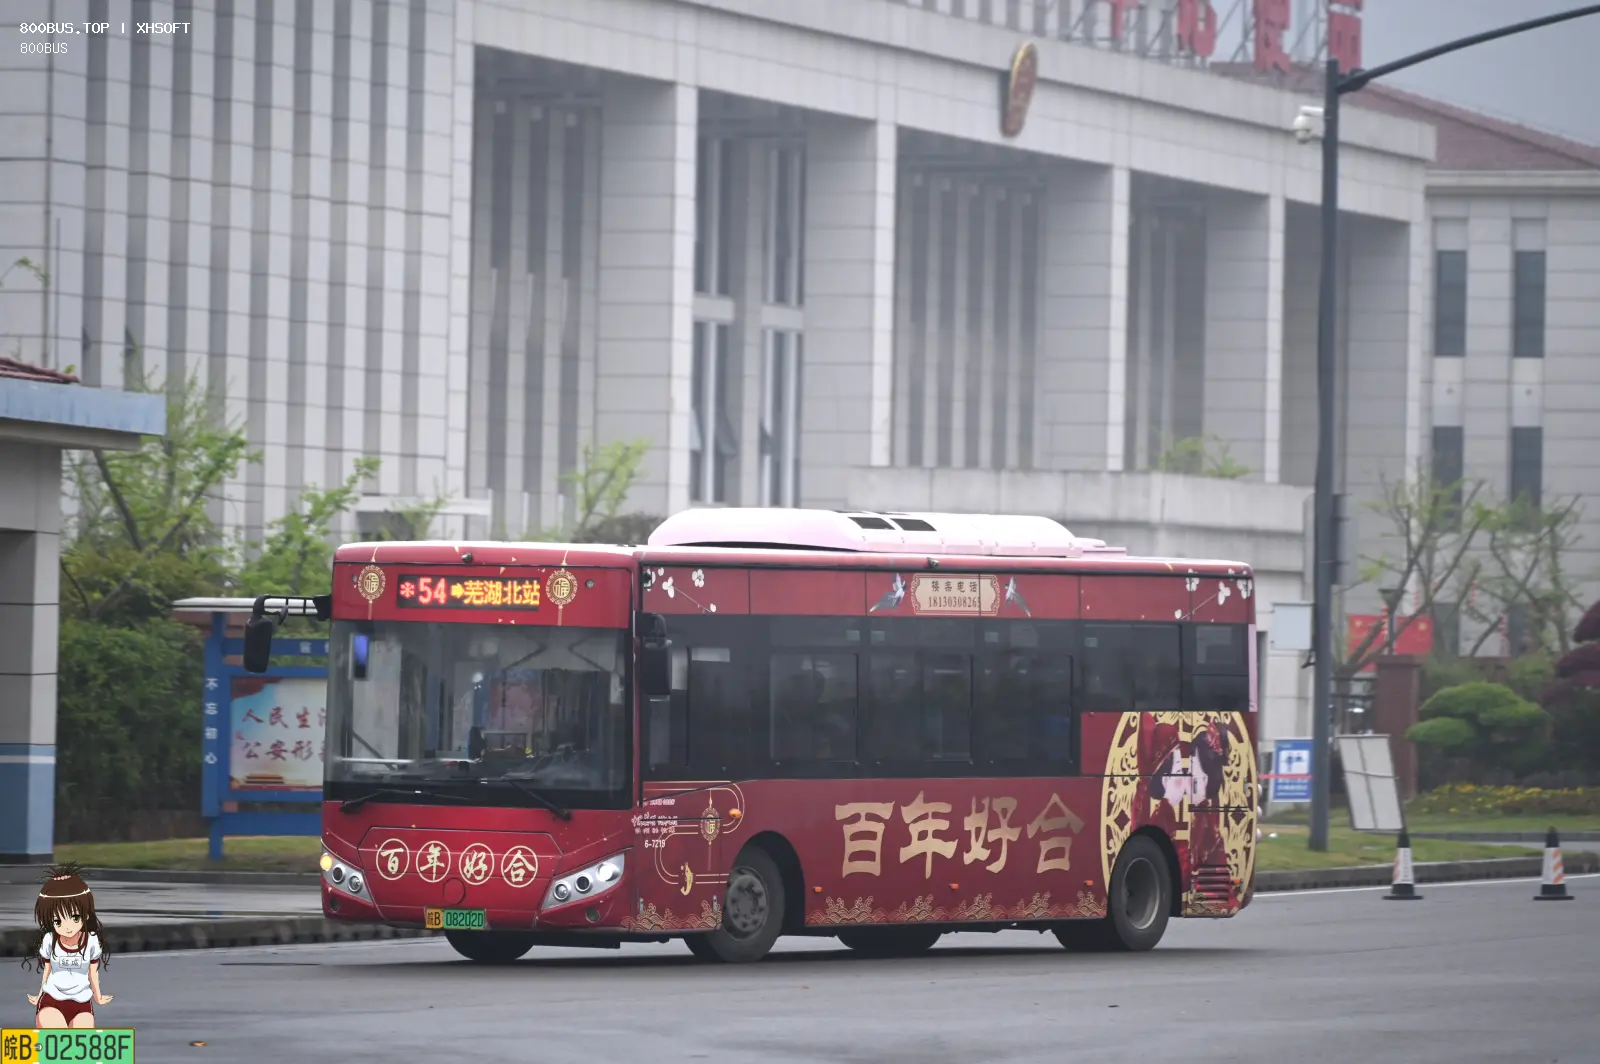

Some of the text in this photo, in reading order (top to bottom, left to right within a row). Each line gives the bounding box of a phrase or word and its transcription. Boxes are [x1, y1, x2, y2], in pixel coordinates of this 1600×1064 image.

[418, 577, 541, 606] 54 芜湖北站
[204, 677, 219, 765] 不忘初心
[644, 839, 666, 849] 6-7219
[835, 790, 1085, 880] 百年好合
[380, 843, 536, 883] 百年好合
